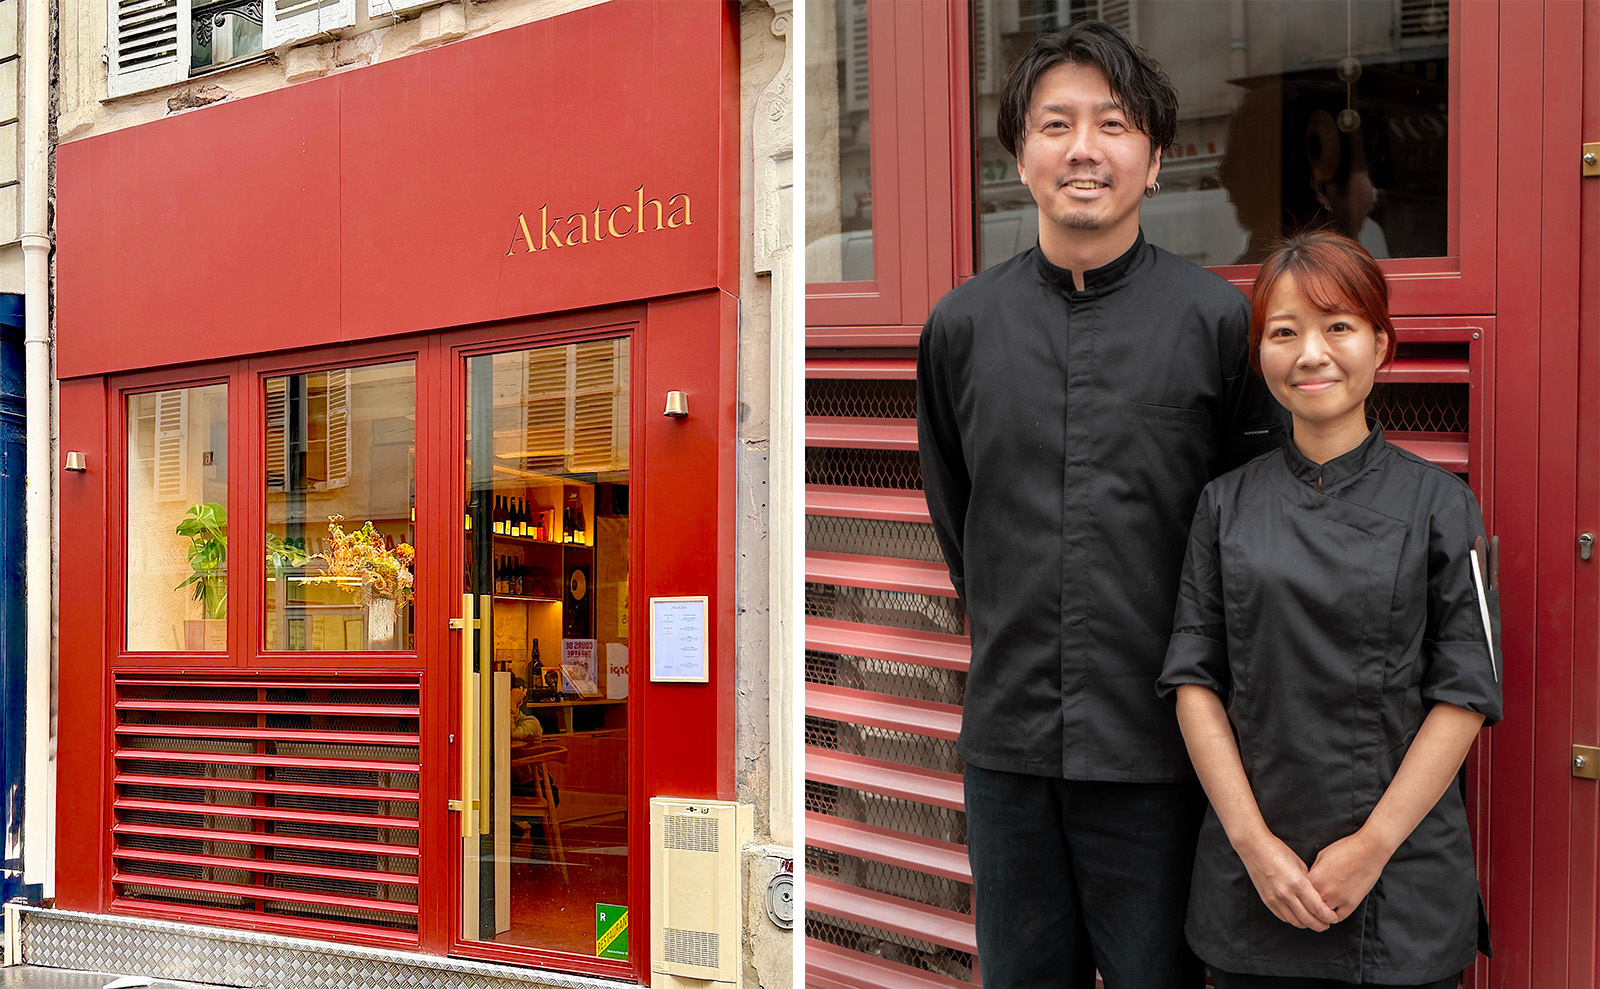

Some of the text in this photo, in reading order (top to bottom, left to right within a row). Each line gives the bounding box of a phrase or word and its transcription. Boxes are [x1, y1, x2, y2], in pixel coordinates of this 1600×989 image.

[505, 184, 694, 257] Akatcha
[597, 914, 628, 954] RESTAURAN
[600, 912, 606, 922] R
